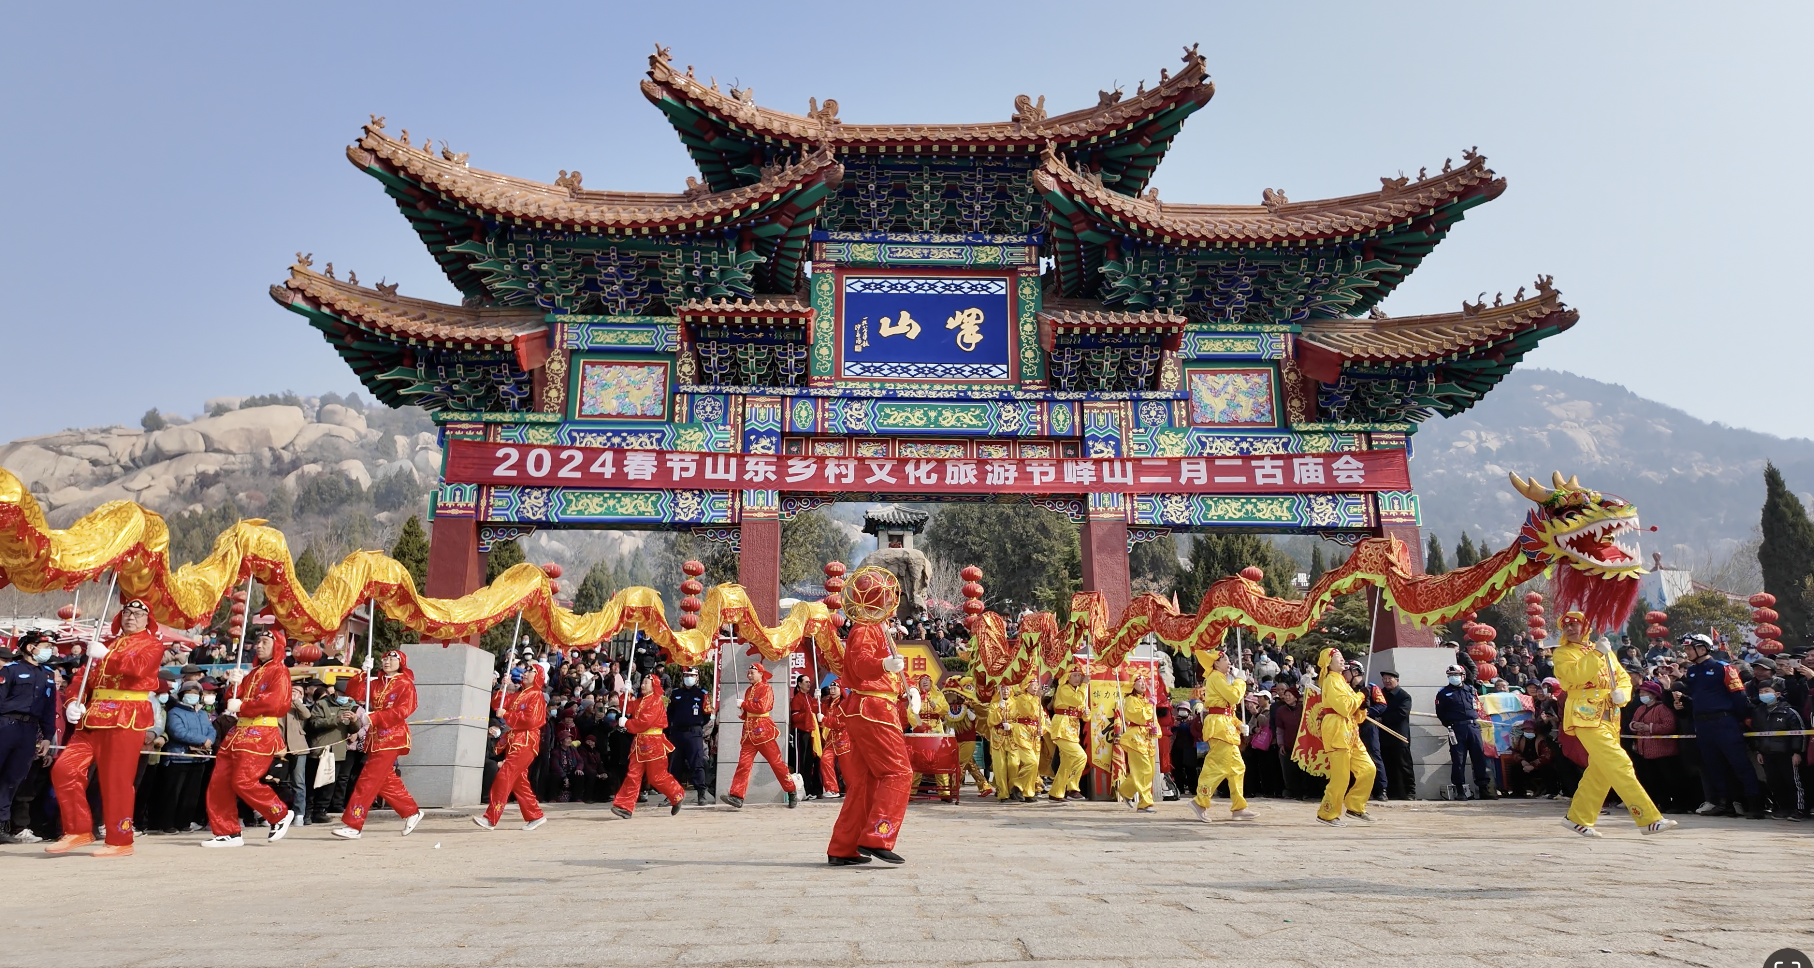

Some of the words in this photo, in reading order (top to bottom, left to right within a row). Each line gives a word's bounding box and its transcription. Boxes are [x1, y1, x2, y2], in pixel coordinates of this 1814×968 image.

[493, 447, 1365, 485] 2024春节山东乡村文化旅游节峄山二月二古庙会
